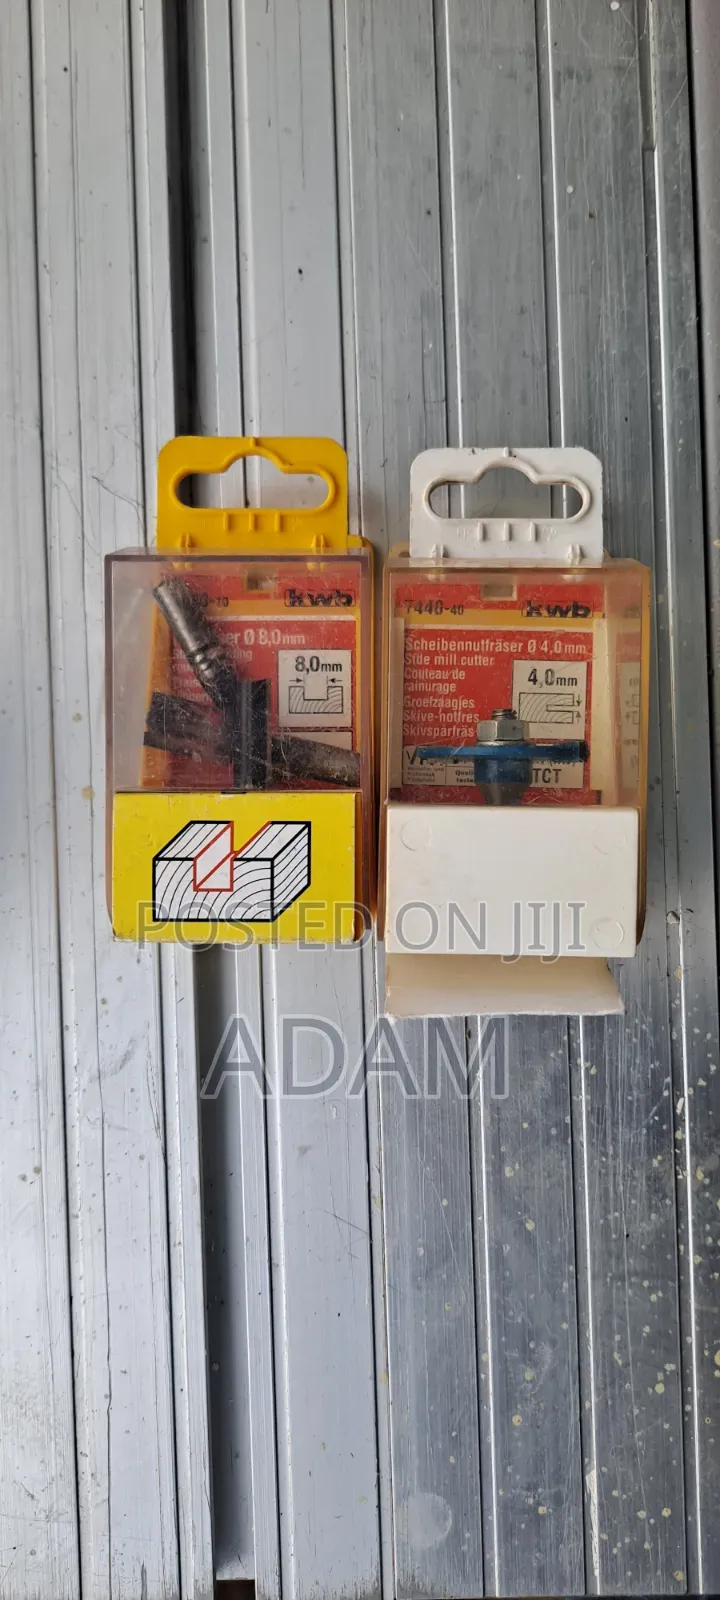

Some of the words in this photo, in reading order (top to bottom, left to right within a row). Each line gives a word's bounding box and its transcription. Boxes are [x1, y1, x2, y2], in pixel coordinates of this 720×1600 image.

[288, 589, 352, 607] kwb
[526, 601, 591, 618] kwb
[295, 656, 343, 674] 8,0mm
[405, 653, 430, 665] Side
[434, 654, 457, 666] mill
[460, 655, 495, 667] cutter
[452, 669, 466, 680] de
[527, 668, 578, 689] 4,0mm
